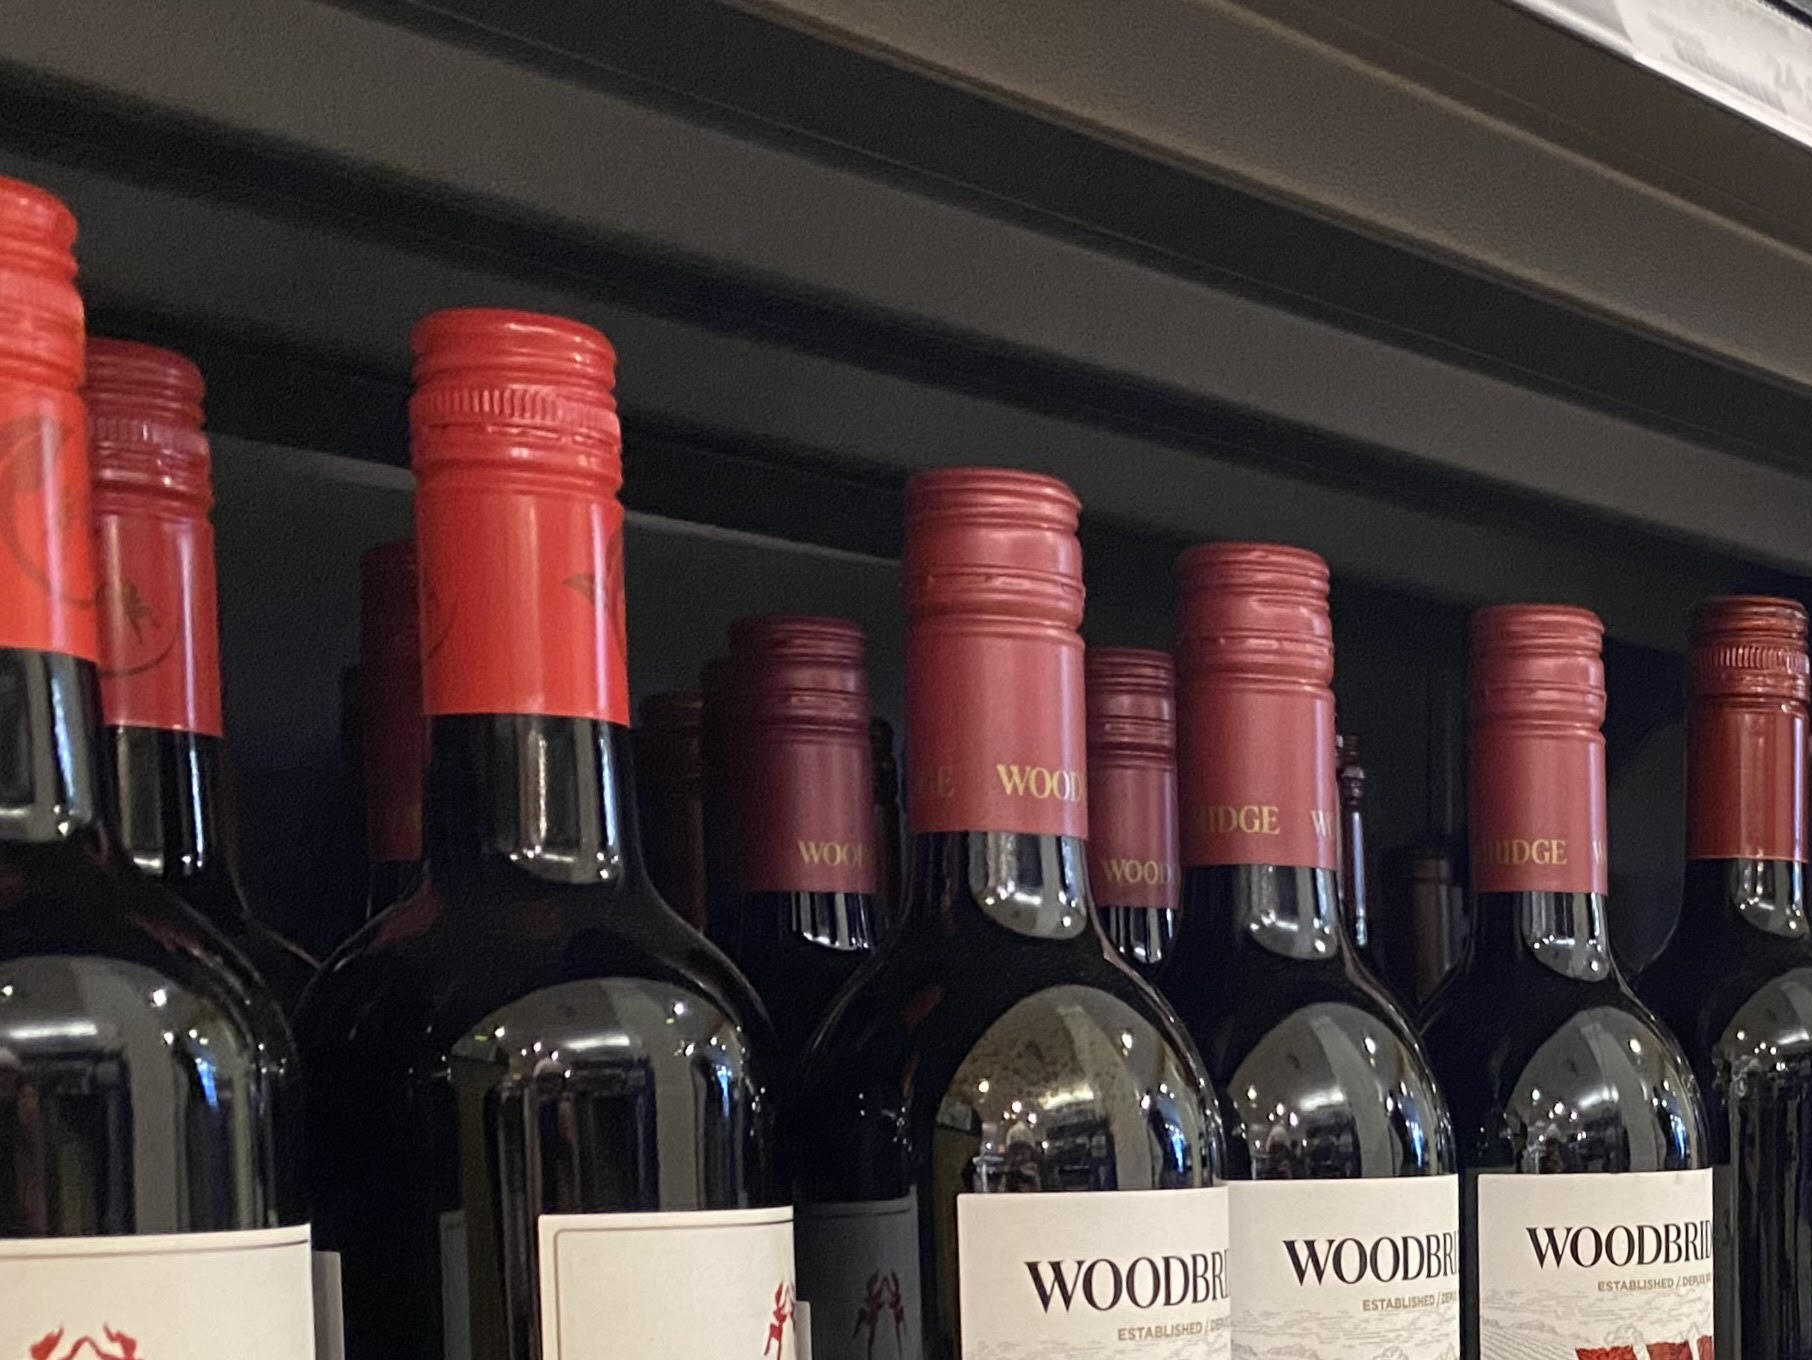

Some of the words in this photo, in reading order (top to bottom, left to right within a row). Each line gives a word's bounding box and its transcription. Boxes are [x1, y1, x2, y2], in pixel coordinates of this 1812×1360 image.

[1598, 1277, 1674, 1293] ESTABLISHED
[1362, 1295, 1435, 1313] ESTABLISHED
[1117, 1318, 1203, 1342] ESTABLISHED
